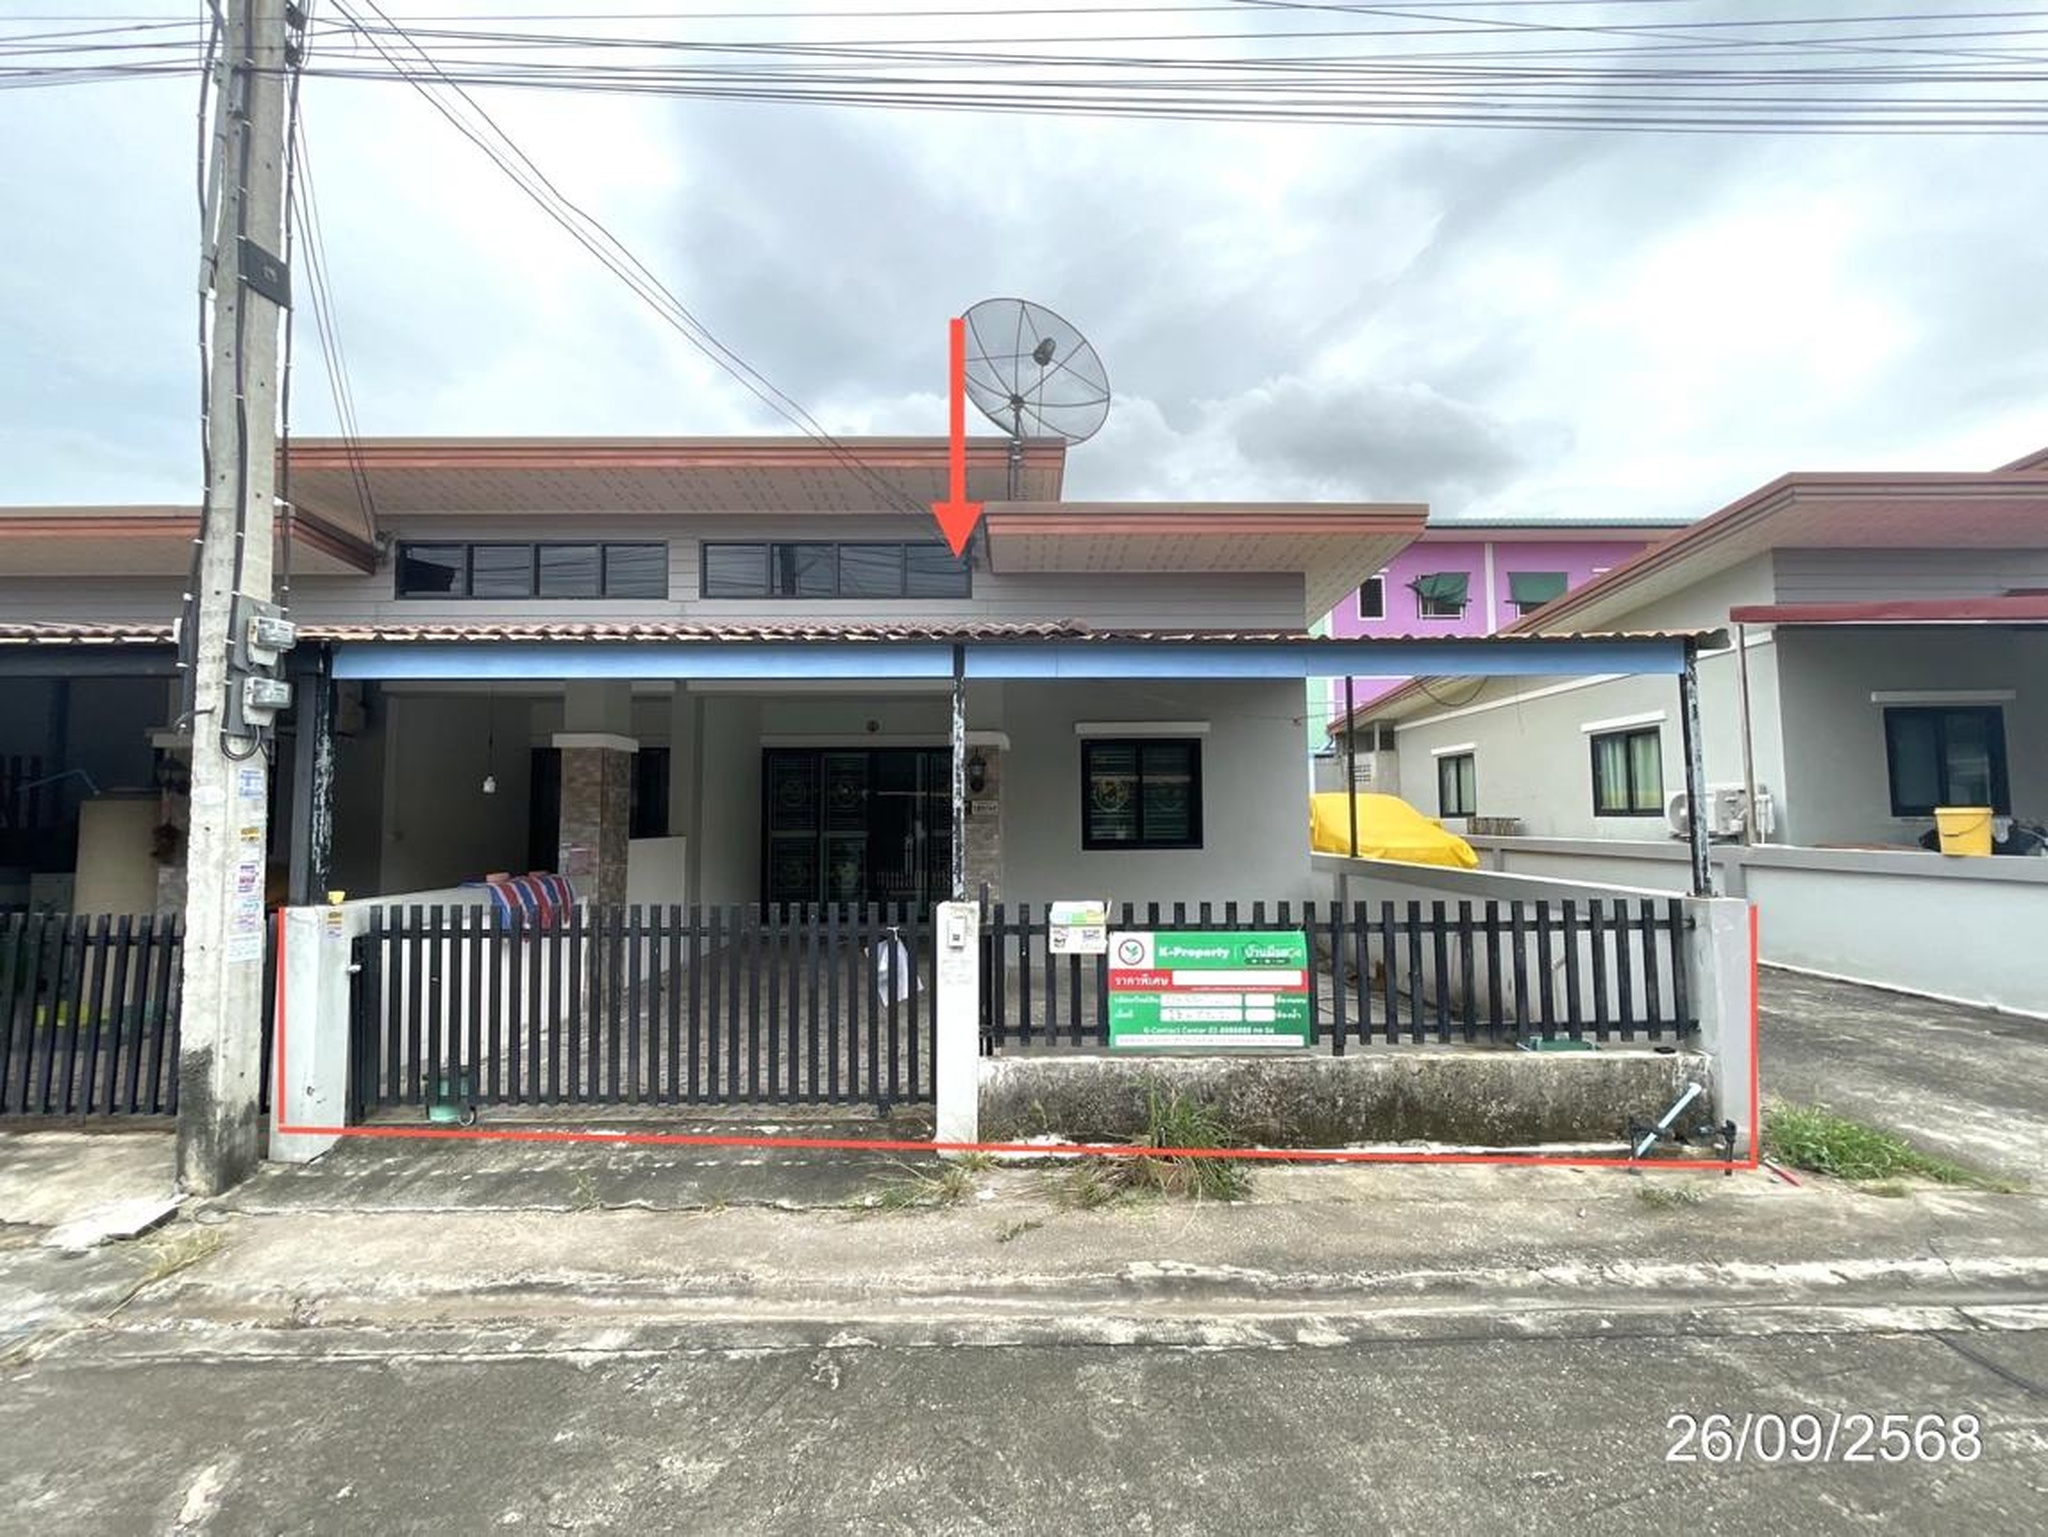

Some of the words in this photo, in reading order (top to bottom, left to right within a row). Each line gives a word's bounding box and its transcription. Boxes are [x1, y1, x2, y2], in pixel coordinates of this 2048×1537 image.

[1158, 945, 1230, 959] K-Property
[1115, 973, 1169, 987] ราคาพิเศษ
